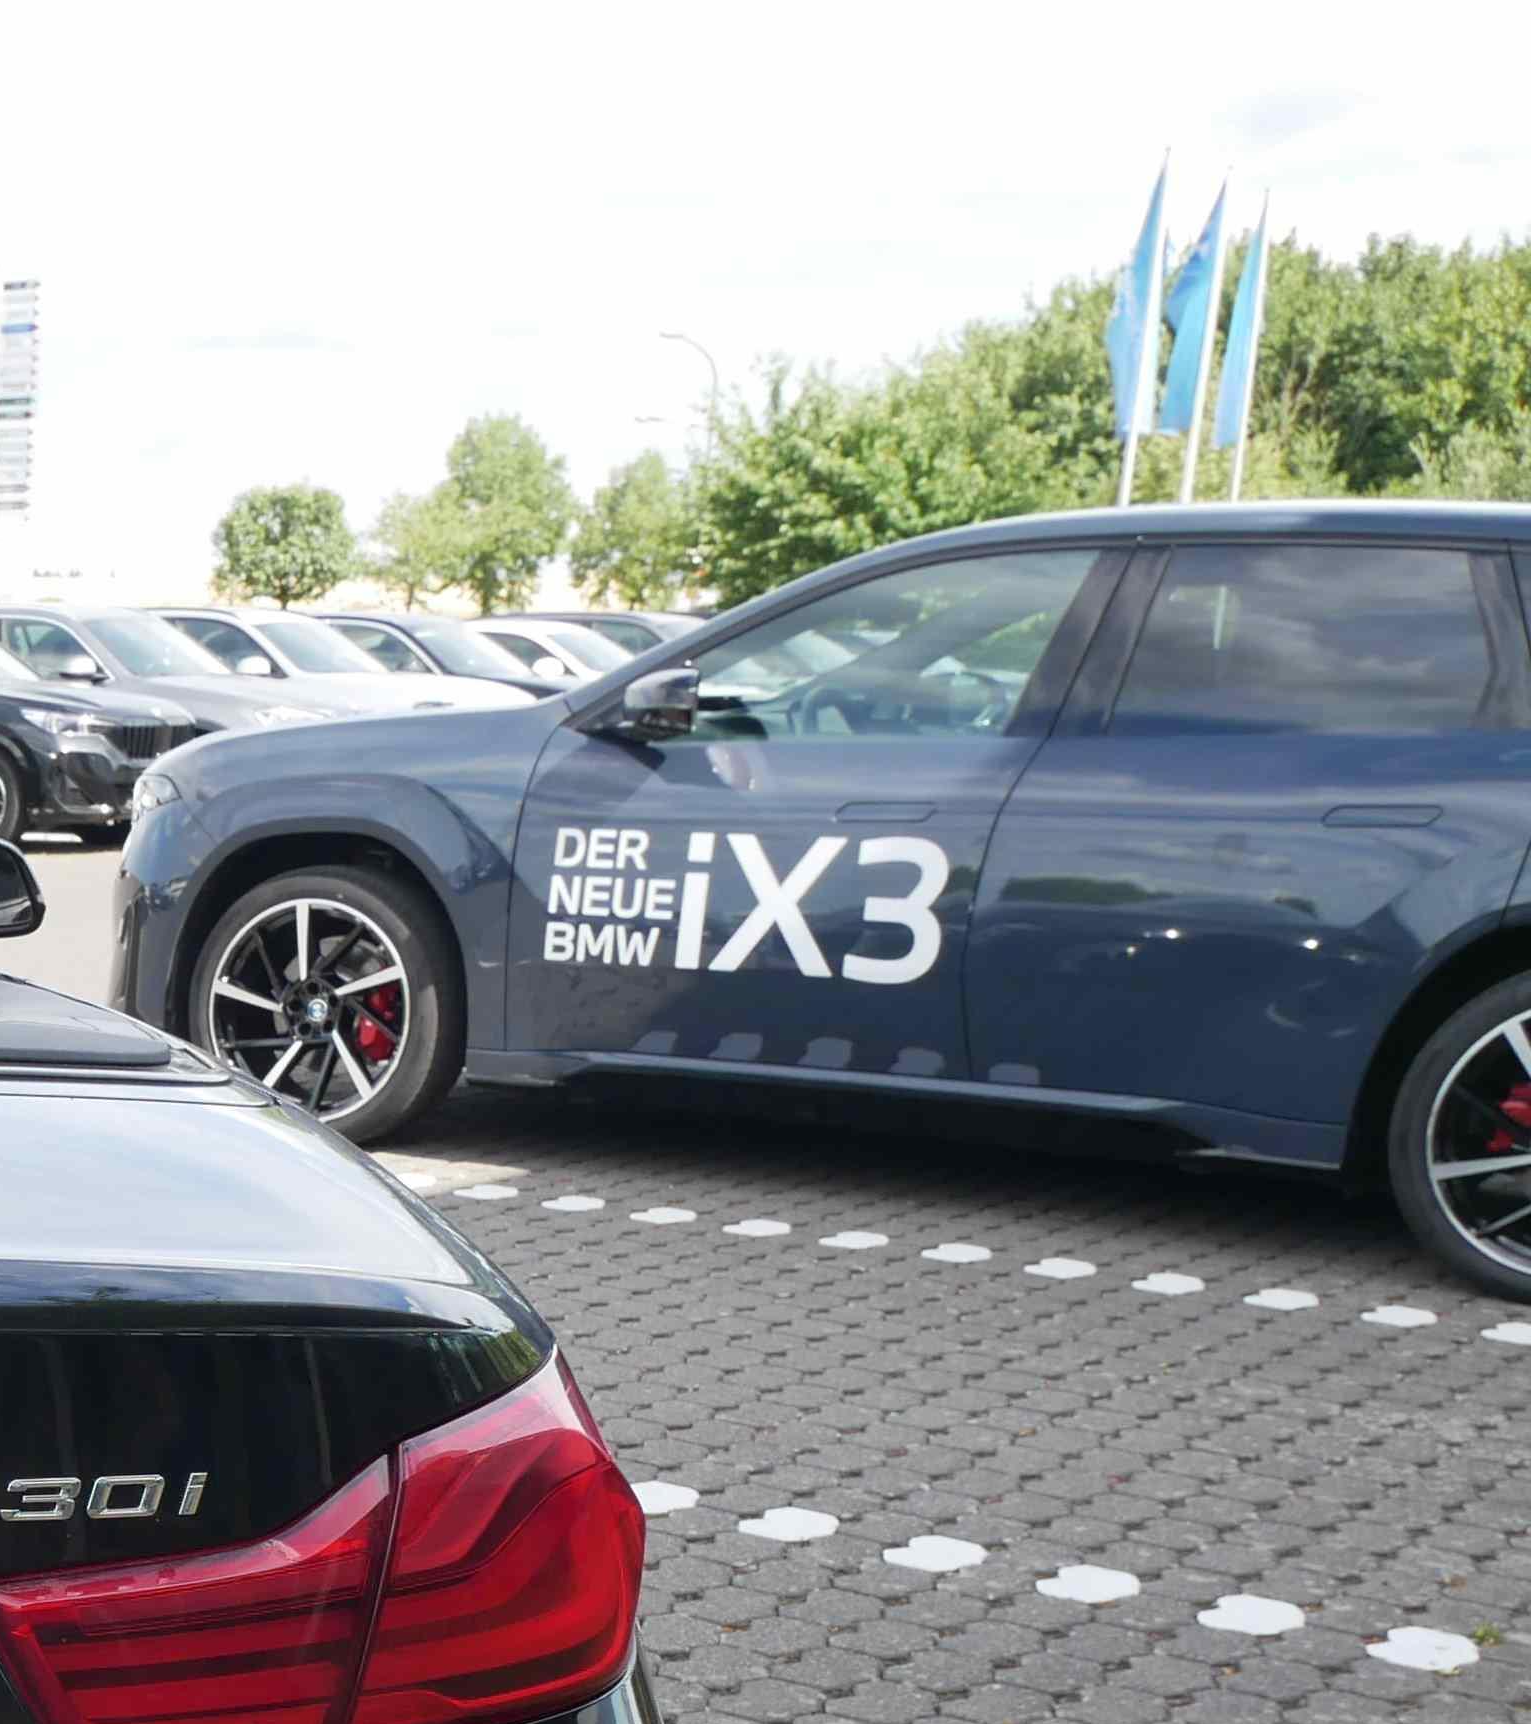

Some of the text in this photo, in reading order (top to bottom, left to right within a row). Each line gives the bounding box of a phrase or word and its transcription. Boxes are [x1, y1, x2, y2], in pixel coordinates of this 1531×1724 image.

[552, 827, 650, 870] DER
[546, 874, 677, 920] NEUE
[674, 830, 951, 985] iX3
[543, 921, 660, 967] BMW
